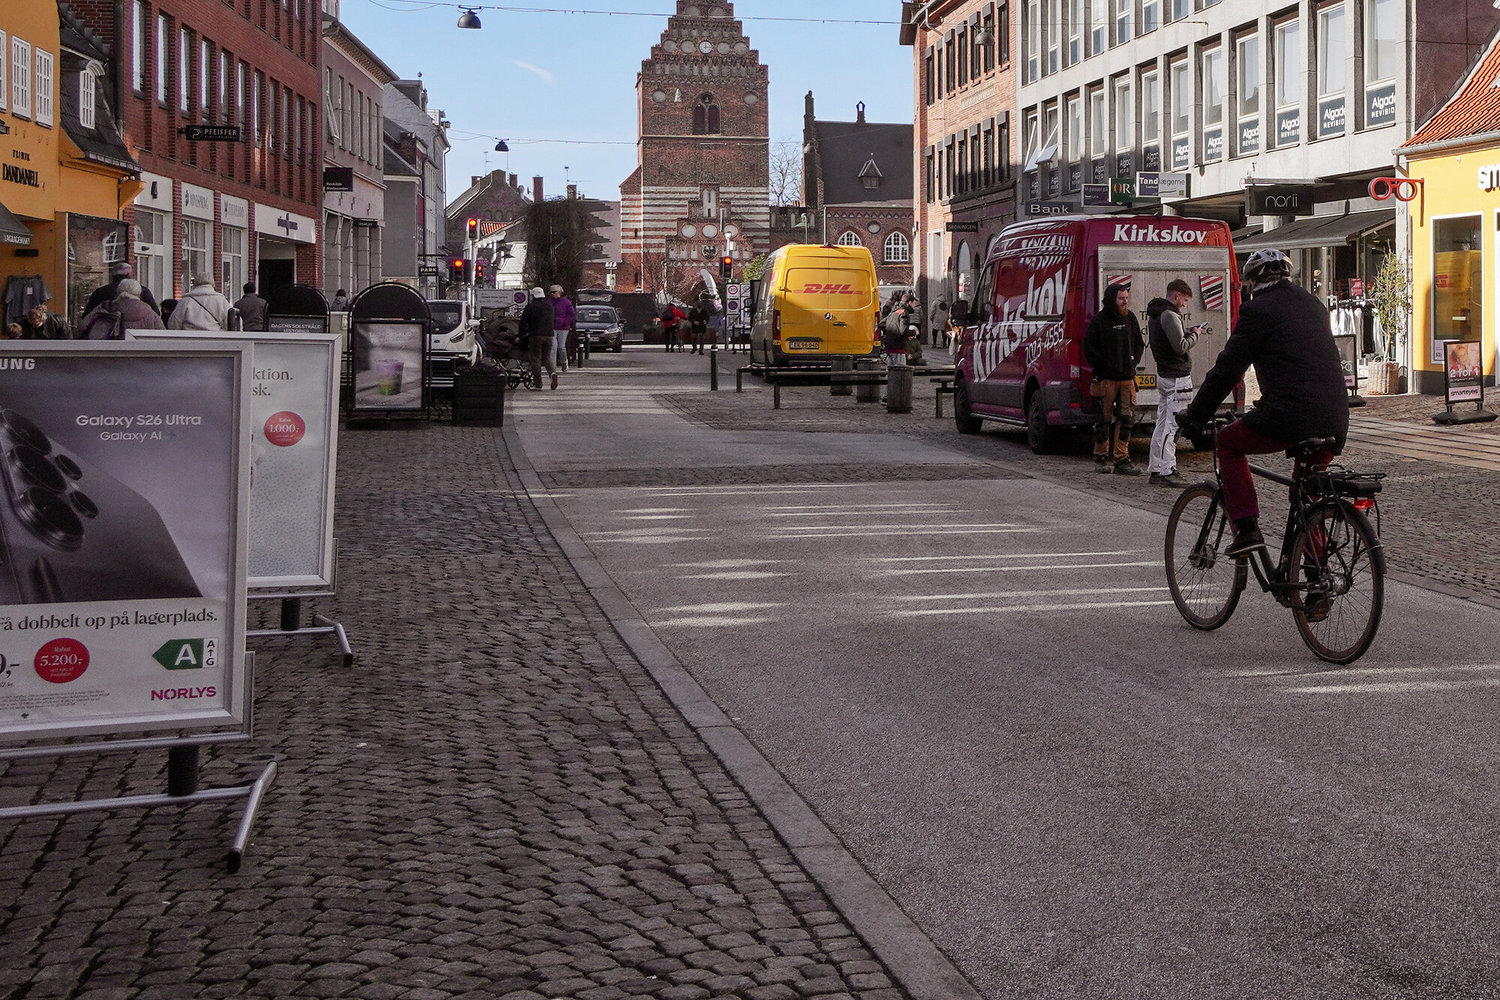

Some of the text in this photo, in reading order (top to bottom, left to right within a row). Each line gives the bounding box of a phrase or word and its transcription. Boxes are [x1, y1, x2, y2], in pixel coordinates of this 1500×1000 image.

[204, 128, 237, 136] PFEIFFER
[1265, 193, 1298, 208] norii
[1030, 204, 1069, 214] Bank
[1113, 224, 1207, 243] Kirkskov
[803, 284, 851, 294] DHL
[1450, 367, 1478, 378] 2 for 1
[1139, 376, 1155, 385] 260
[76, 415, 202, 428] Galaxy S26 Ultra
[100, 432, 162, 442] Galaxy AI
[18, 614, 80, 630] dobbelt
[85, 617, 105, 629] op
[110, 611, 129, 629] på
[135, 608, 217, 625] lagerplads.
[207, 640, 215, 648] A
[174, 644, 196, 665] A
[206, 657, 214, 666] G
[151, 686, 216, 701] NORLYS
